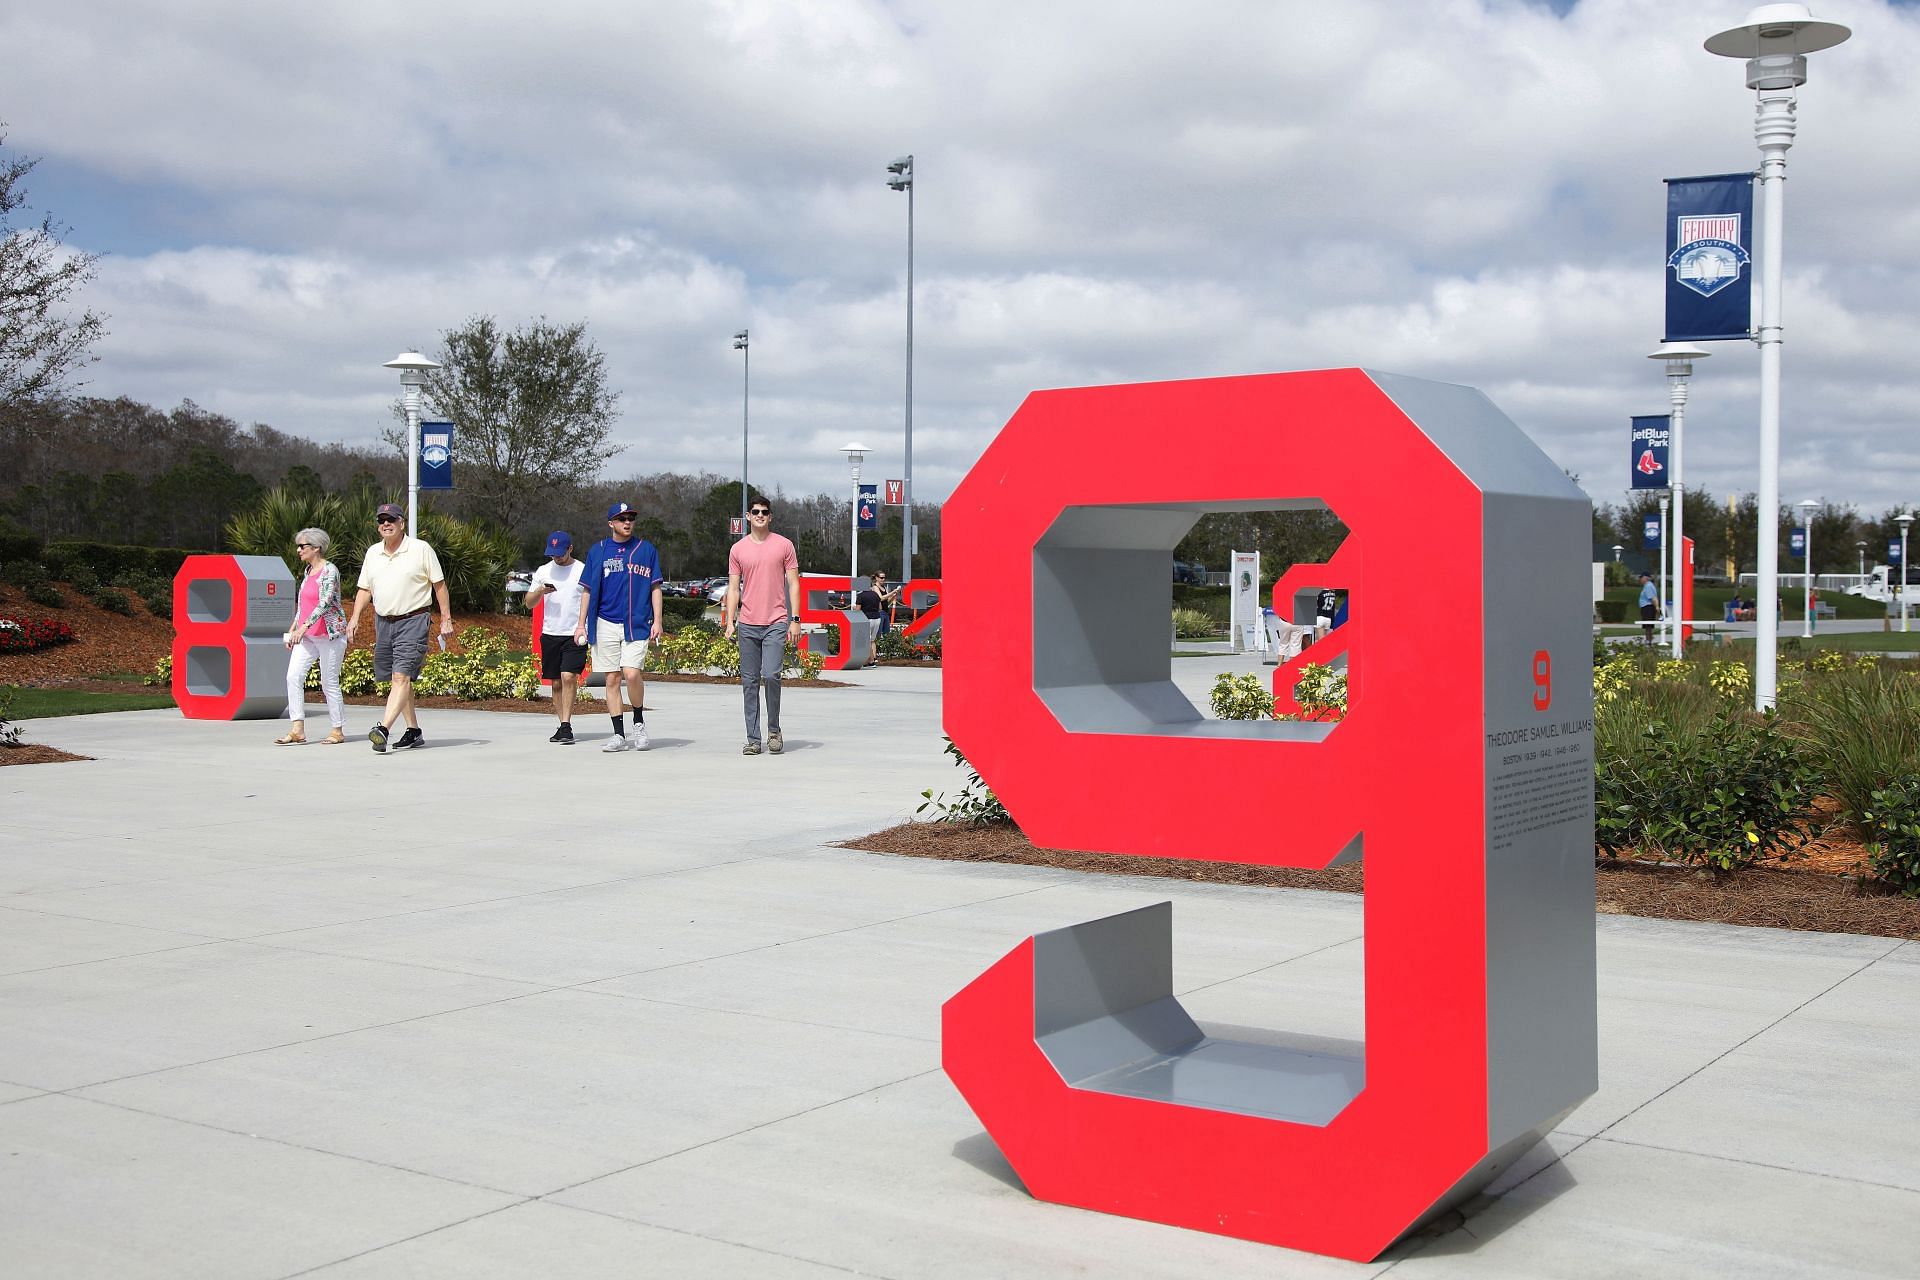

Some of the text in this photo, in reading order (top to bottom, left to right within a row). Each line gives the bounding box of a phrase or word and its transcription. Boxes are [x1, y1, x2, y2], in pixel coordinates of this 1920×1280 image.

[1683, 218, 1735, 244] FENWAY
[1692, 240, 1725, 249] SOUTH
[1632, 428, 1669, 442] jetBlue
[1648, 438, 1669, 447] Park
[888, 481, 901, 493] W
[627, 563, 652, 578] YORK
[172, 554, 249, 720] 8
[1532, 648, 1552, 712] 9
[1487, 719, 1592, 748] THEODORE SAMUEL WILLIAMS
[1503, 754, 1522, 766] BOSTON
[942, 367, 1488, 1262] 9
